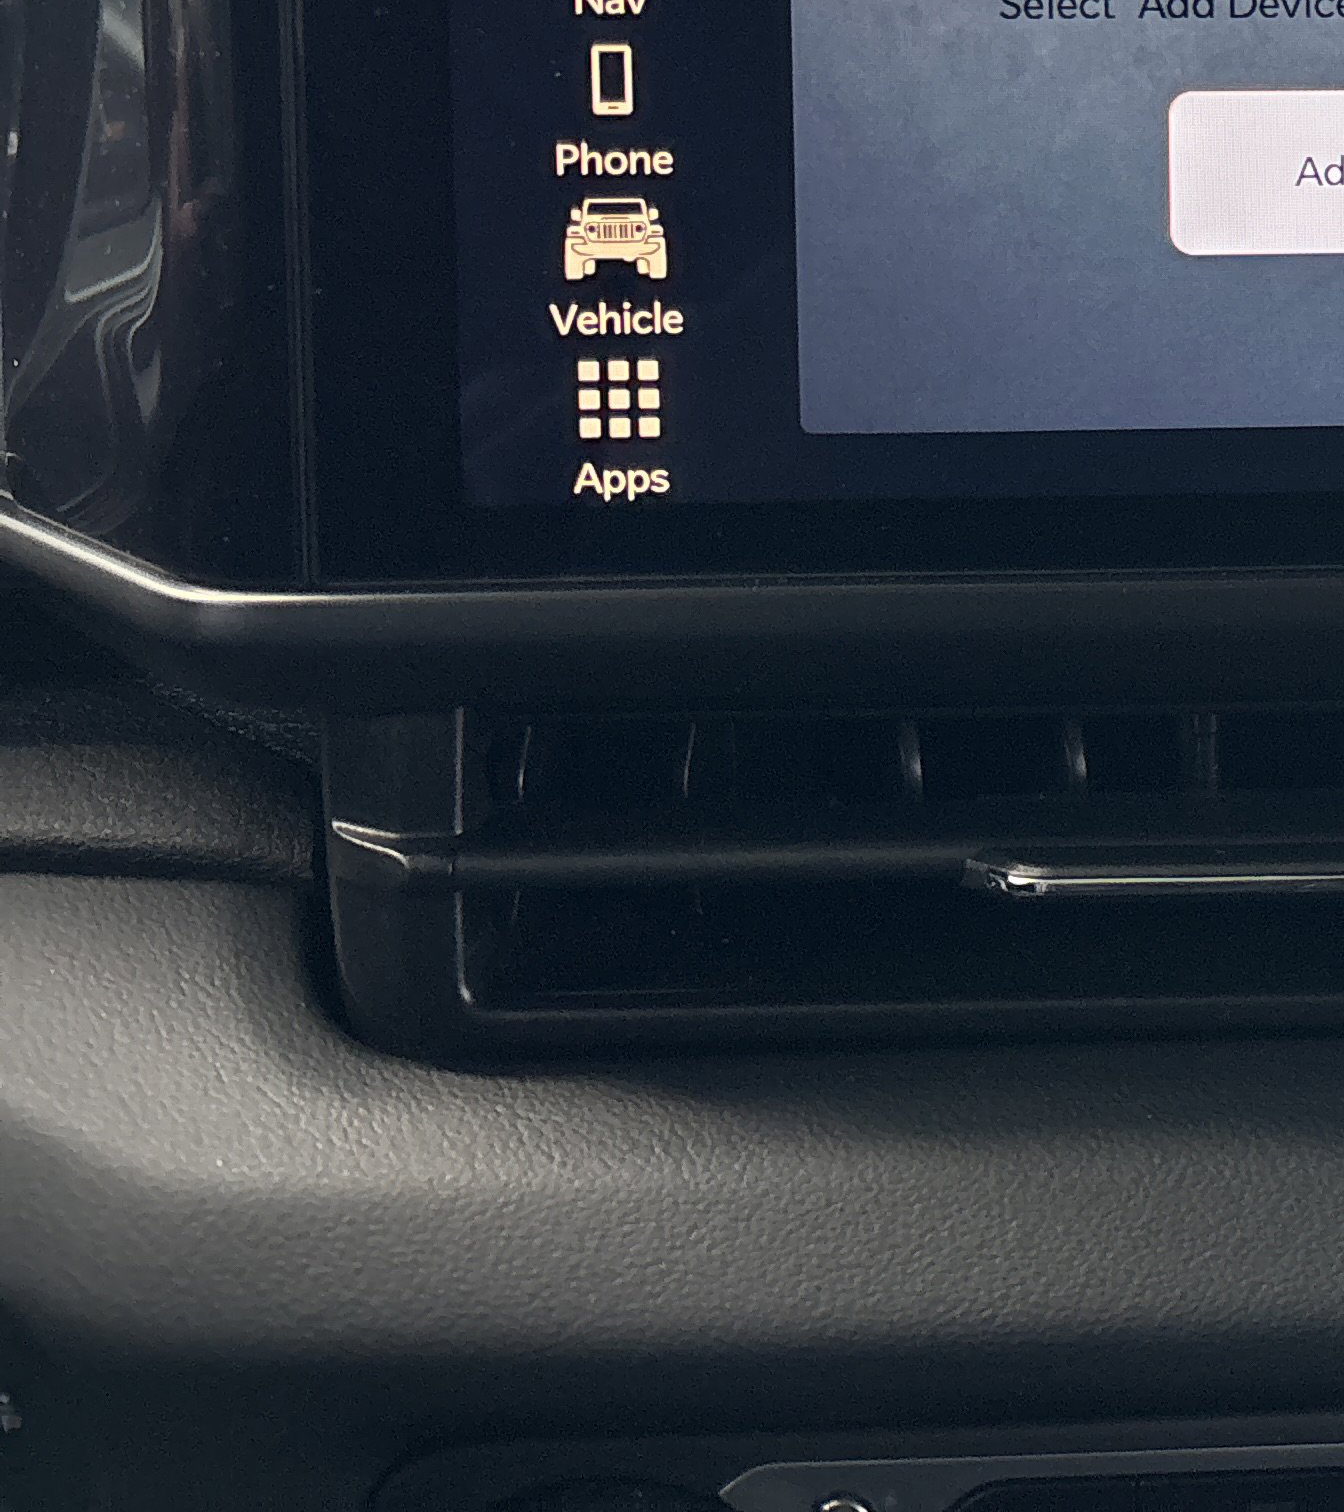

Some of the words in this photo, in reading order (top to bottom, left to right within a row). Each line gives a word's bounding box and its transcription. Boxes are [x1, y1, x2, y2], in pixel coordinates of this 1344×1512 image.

[555, 140, 674, 176] Phone
[549, 301, 684, 336] Vehicle
[573, 463, 671, 502] Apps
